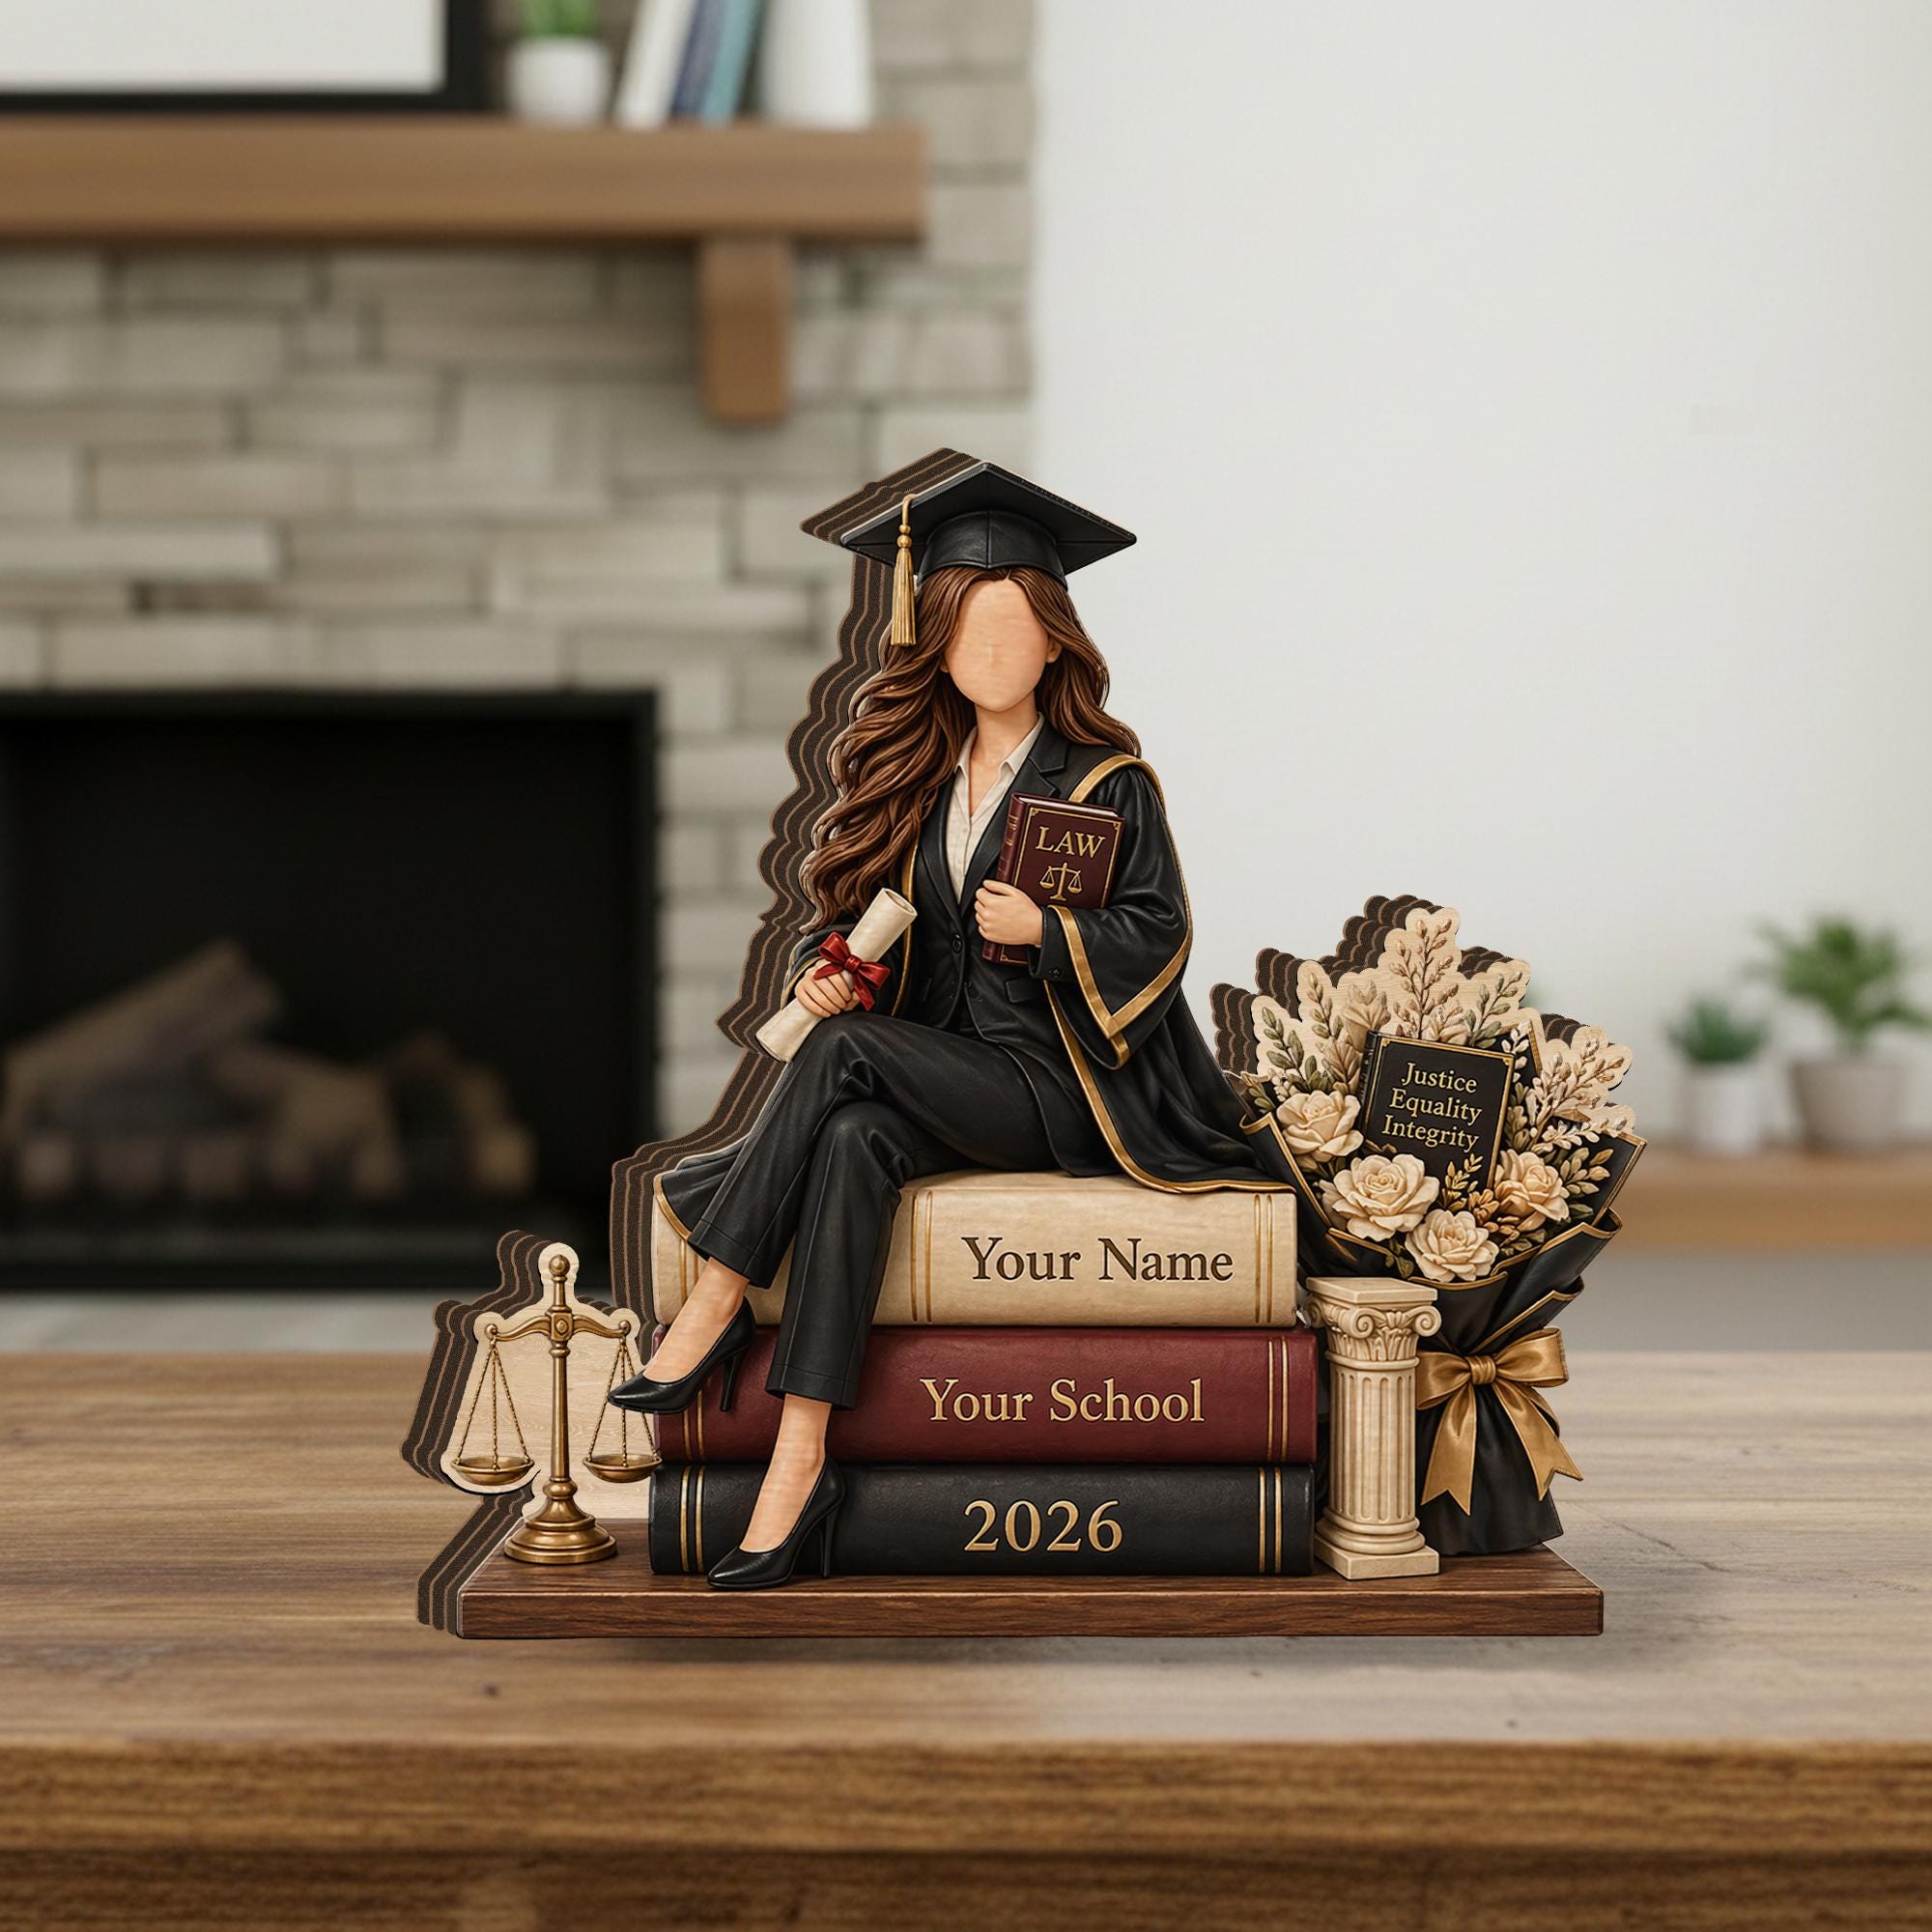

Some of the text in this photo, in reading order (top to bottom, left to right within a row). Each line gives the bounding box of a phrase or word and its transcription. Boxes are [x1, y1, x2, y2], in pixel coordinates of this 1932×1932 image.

[1035, 826, 1106, 859] LAW
[1401, 1062, 1477, 1094] Justice
[1389, 1087, 1483, 1126] Equality
[1381, 1114, 1479, 1152] Integrity
[961, 1236, 1234, 1282] Your Name
[919, 1378, 1205, 1422] Your School
[963, 1499, 1123, 1553] 2026
